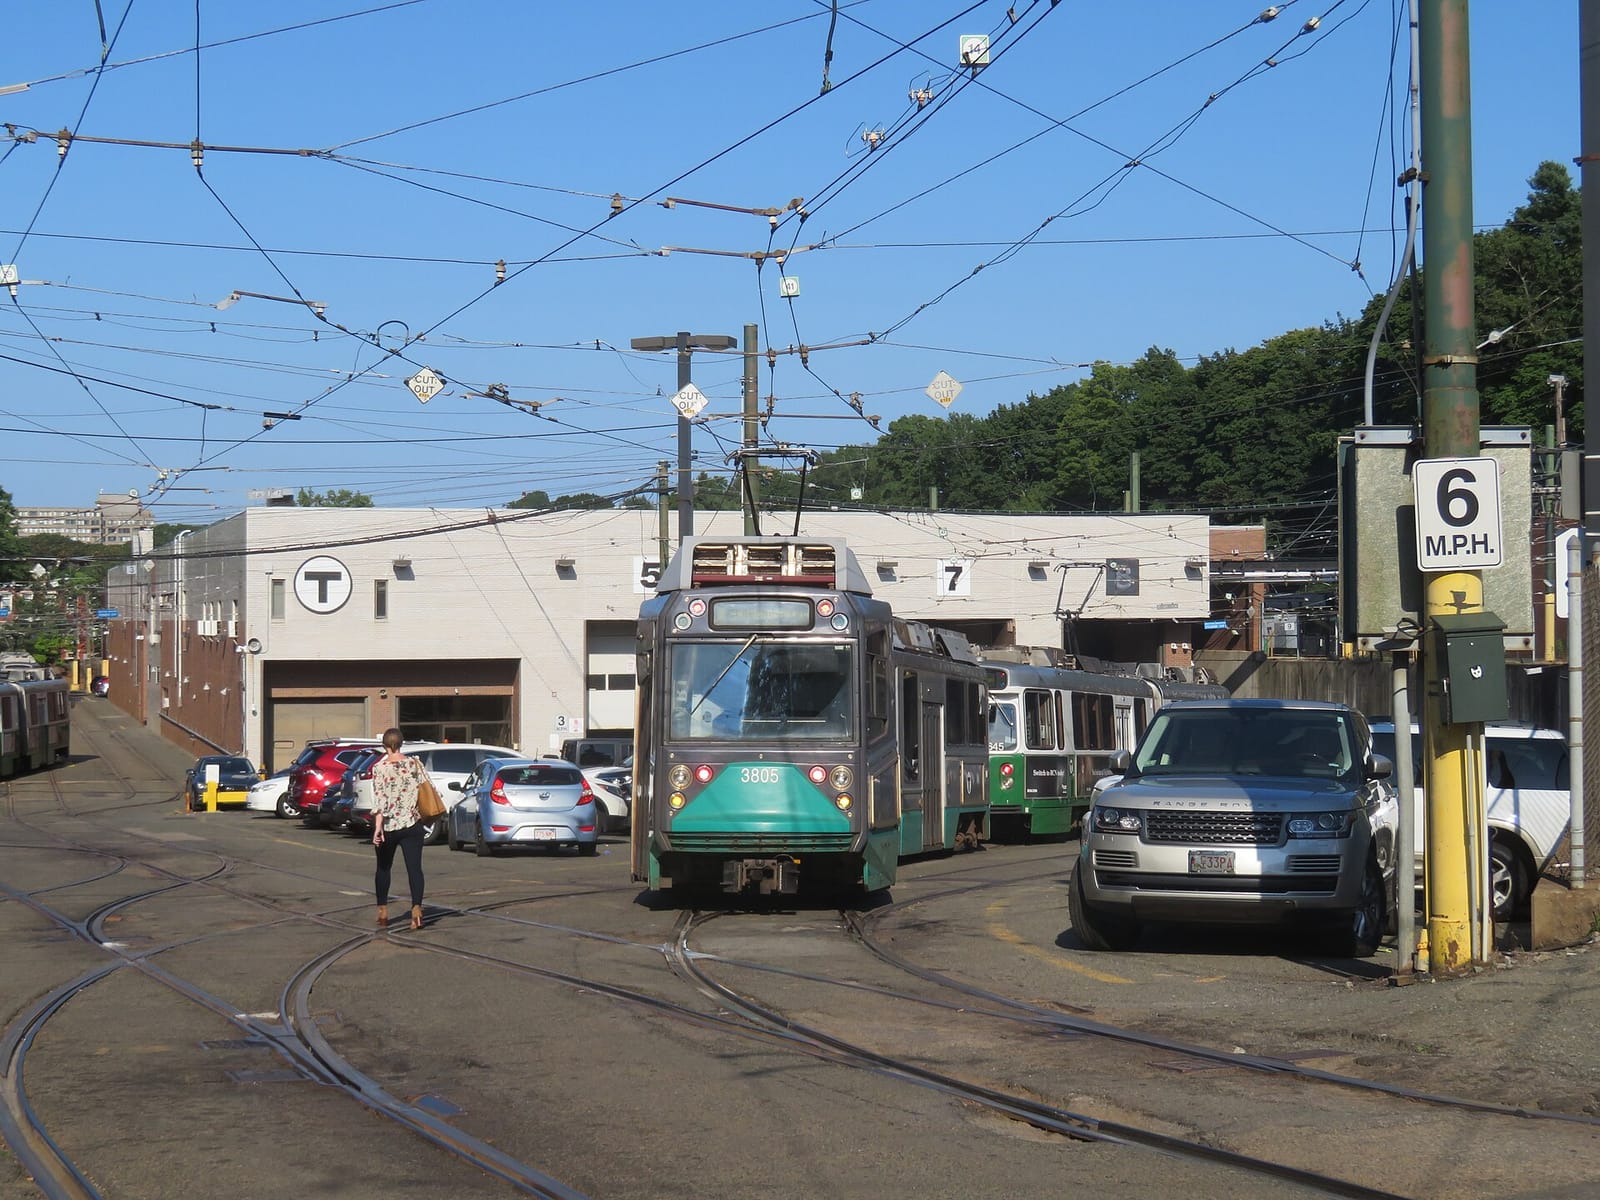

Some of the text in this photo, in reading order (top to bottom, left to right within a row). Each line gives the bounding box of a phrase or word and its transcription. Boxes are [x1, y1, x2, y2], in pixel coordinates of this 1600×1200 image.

[414, 384, 435, 393] OUT
[1437, 468, 1479, 527] 6
[1426, 533, 1495, 557] M.P.H.
[304, 571, 342, 603] T
[640, 562, 661, 588] 5
[945, 566, 963, 591] 7
[558, 715, 565, 726] 3
[740, 767, 779, 783] 3805
